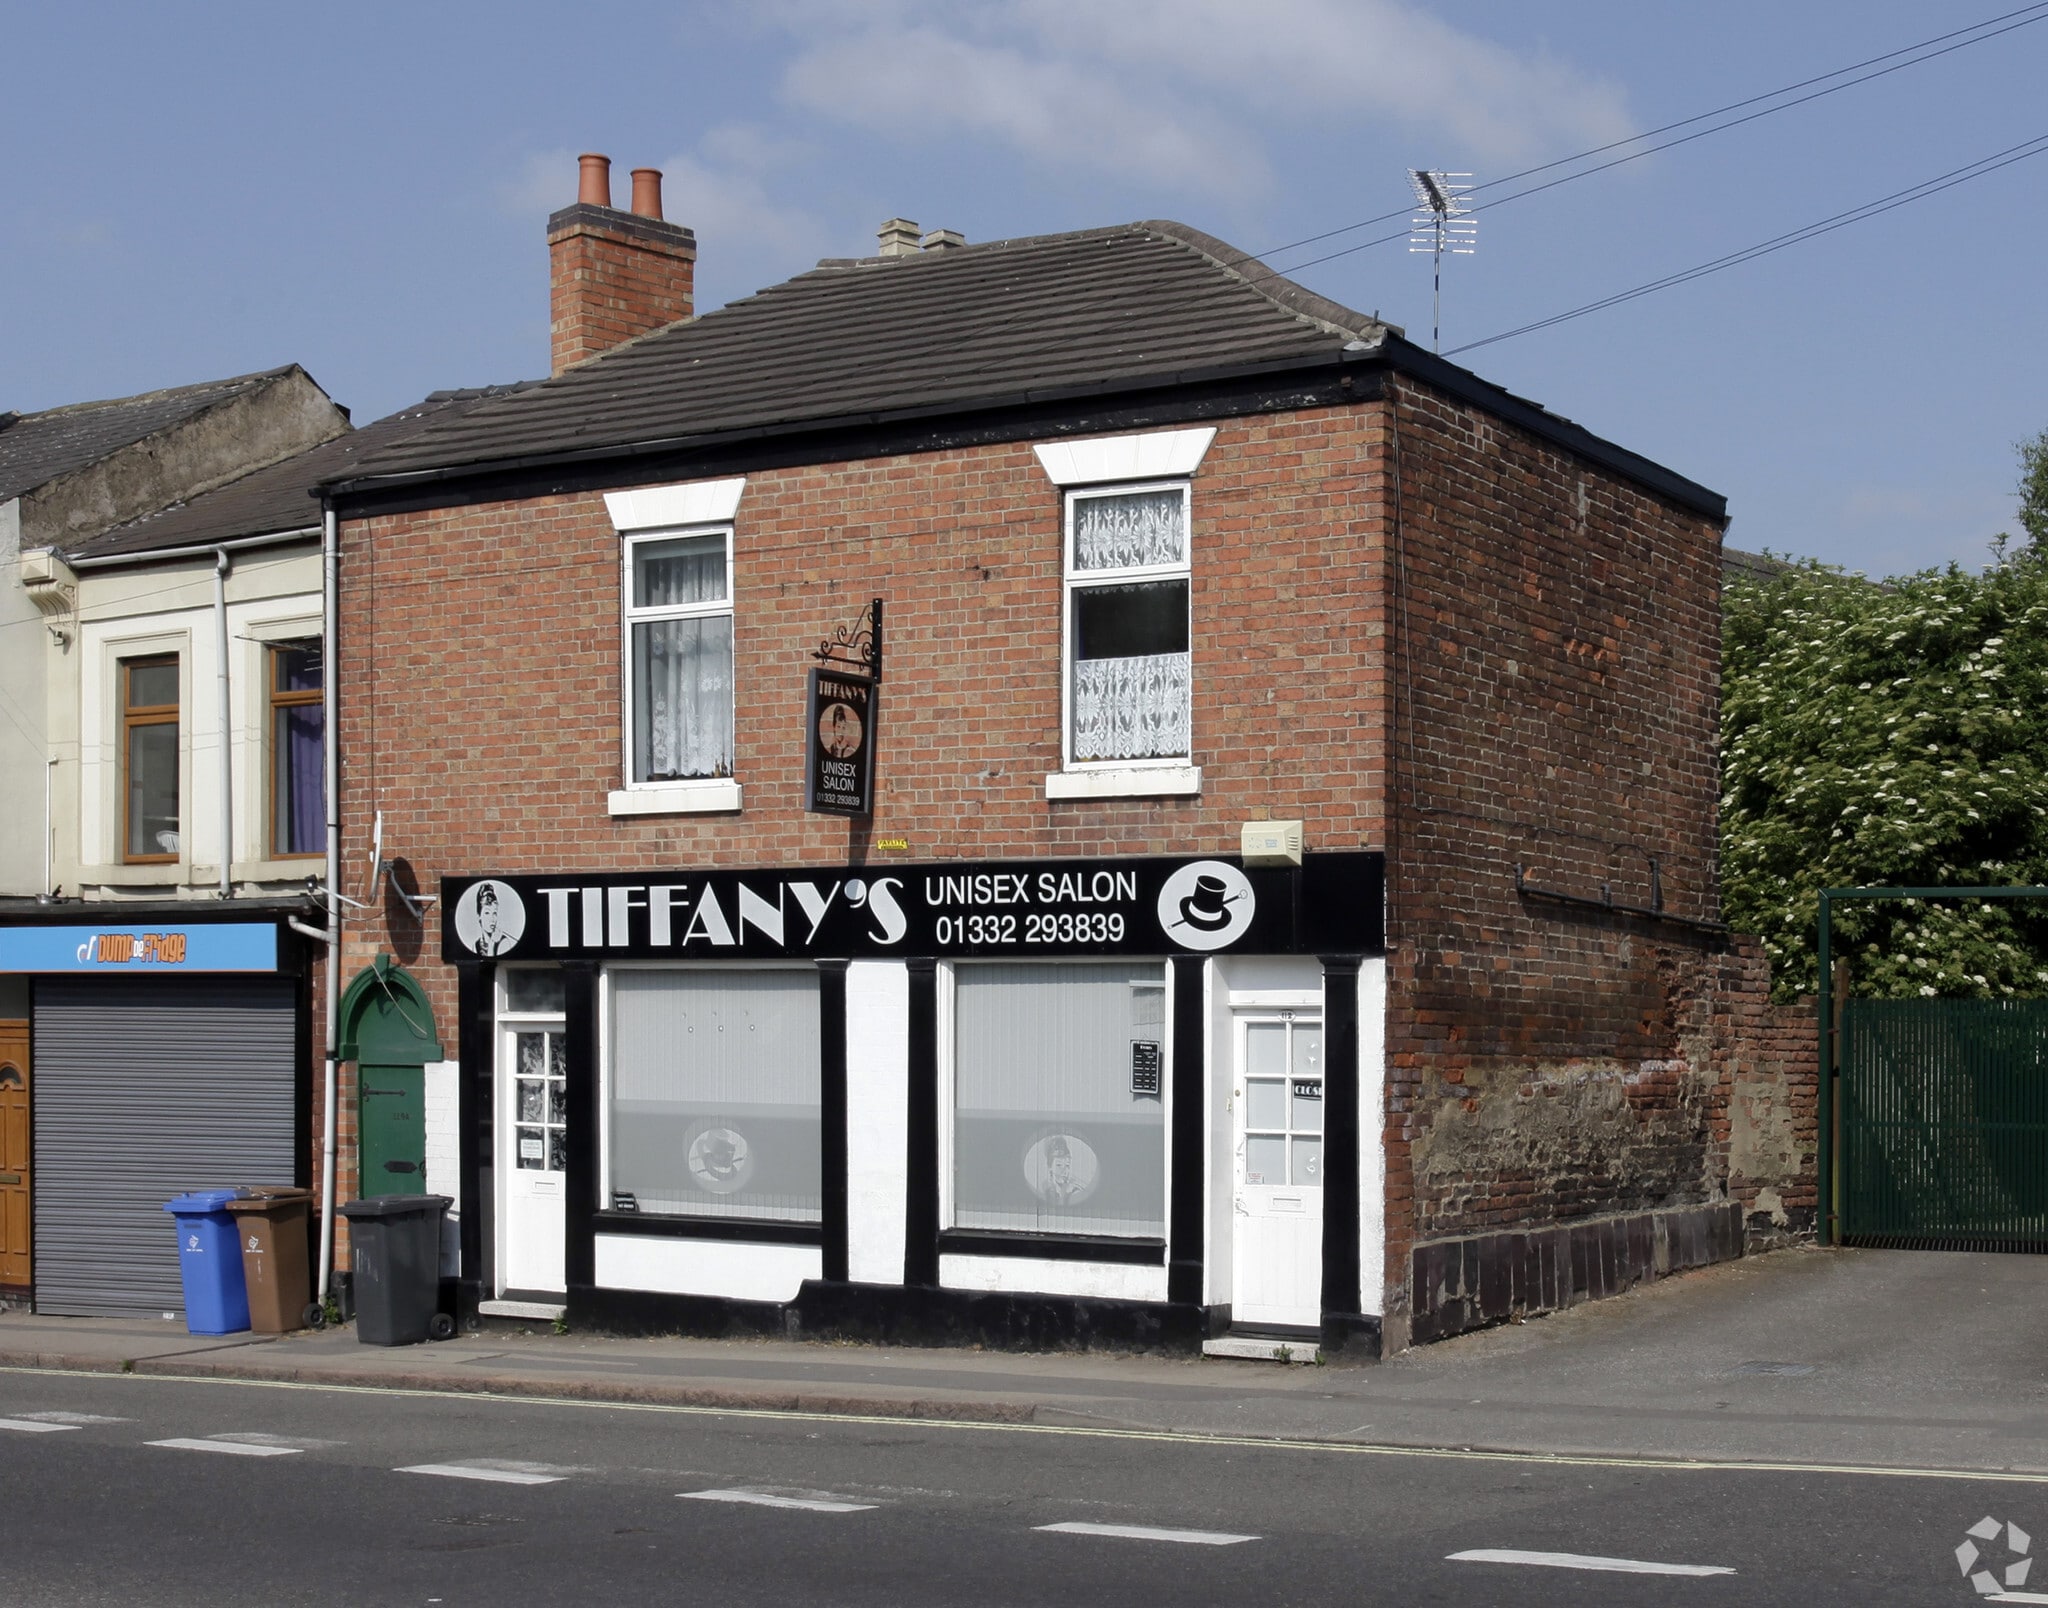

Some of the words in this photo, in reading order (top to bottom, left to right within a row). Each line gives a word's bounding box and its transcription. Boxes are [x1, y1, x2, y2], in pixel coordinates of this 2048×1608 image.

[821, 760, 857, 777] UNISEX
[823, 775, 855, 792] SALON
[816, 792, 836, 803] 01332
[837, 794, 860, 806] 293839
[925, 873, 1030, 906] UNISEX
[1038, 871, 1137, 903] SALON
[537, 877, 908, 948] TIFFANY'S
[936, 915, 1017, 945] 01332
[1025, 913, 1125, 943] 293839
